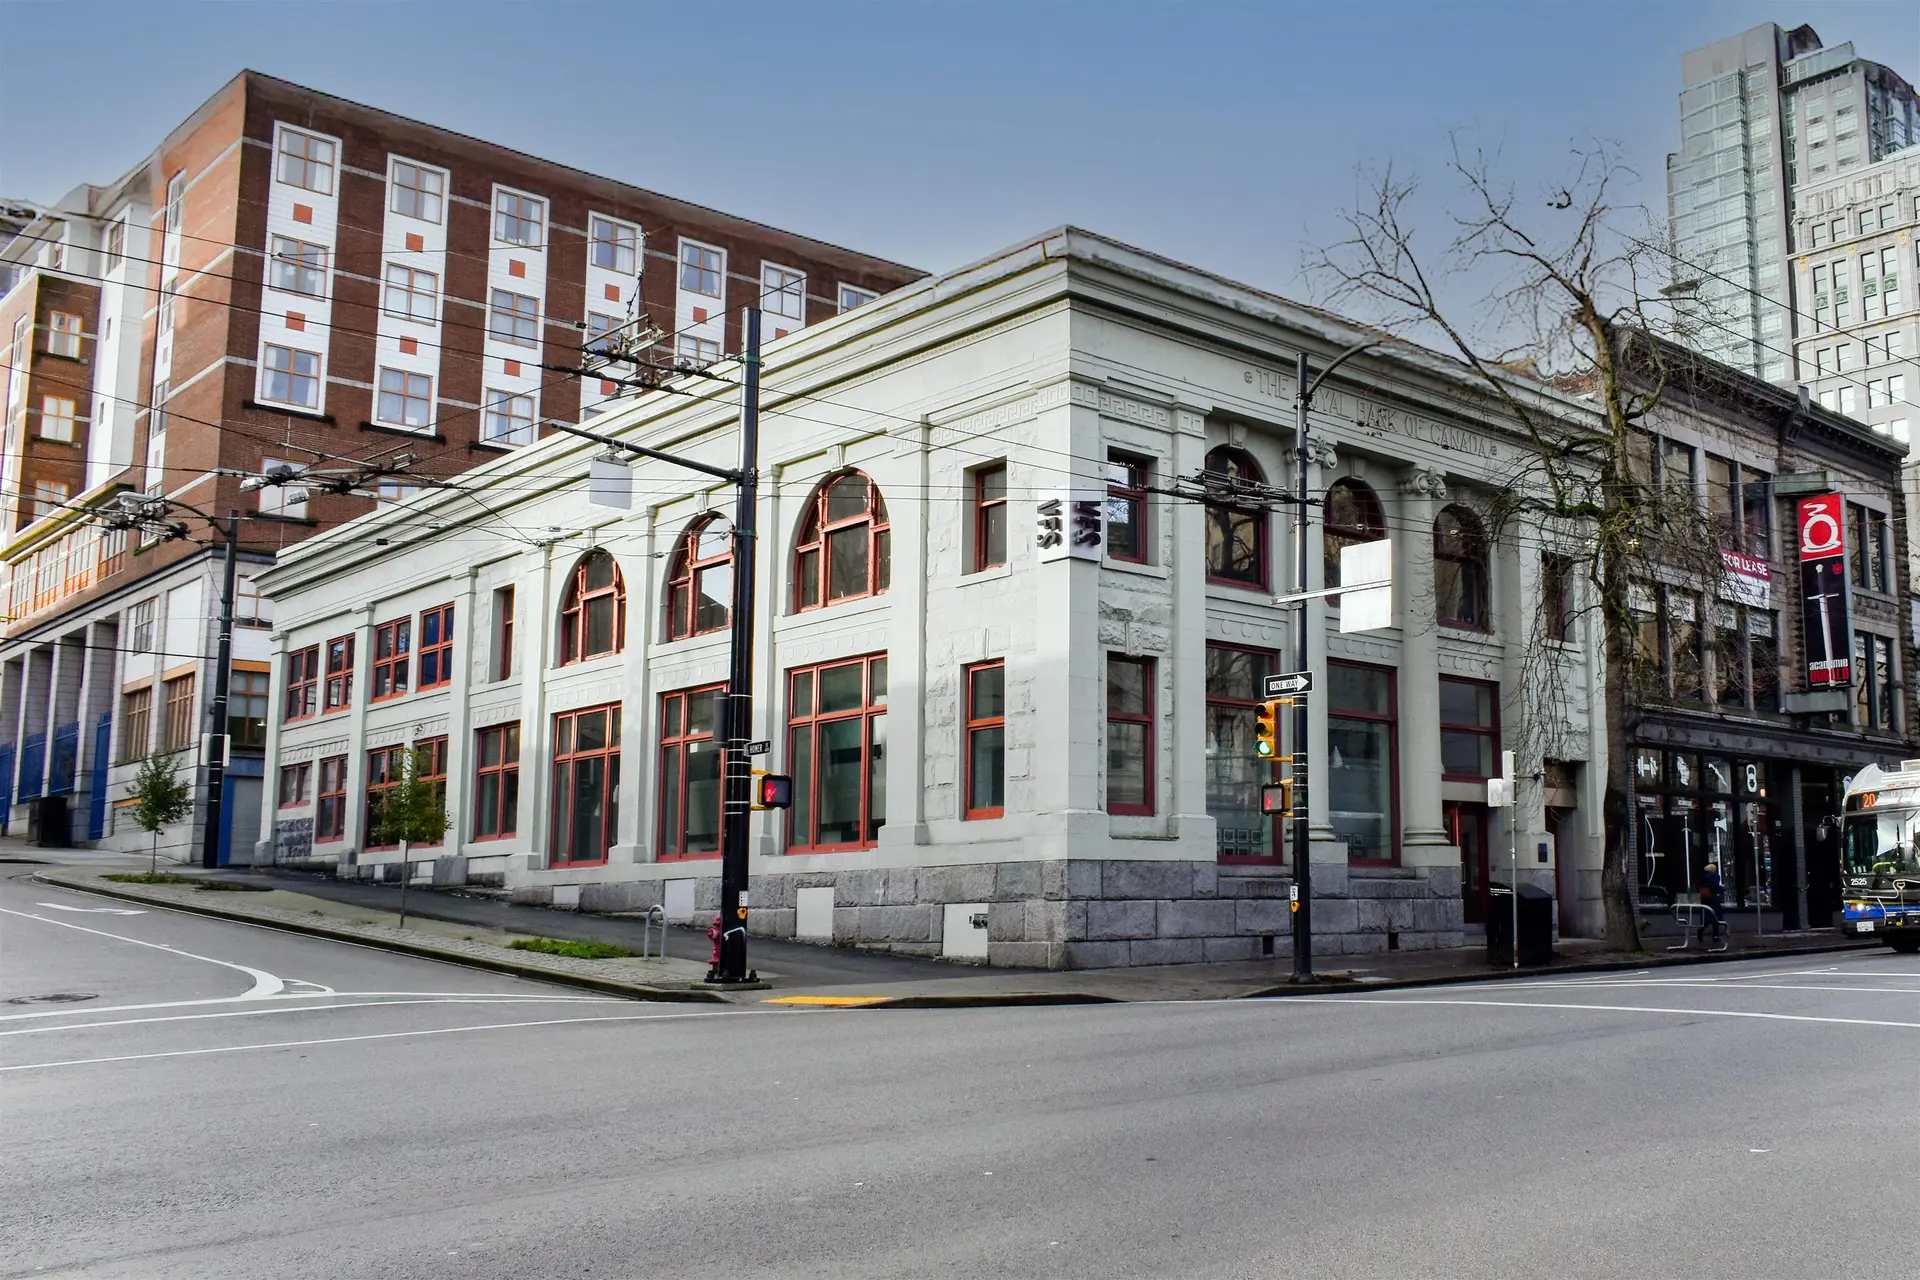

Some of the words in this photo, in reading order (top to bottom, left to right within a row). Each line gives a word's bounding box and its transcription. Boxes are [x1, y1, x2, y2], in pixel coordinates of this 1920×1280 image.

[1256, 368, 1289, 401] THE
[1304, 386, 1351, 418] OYAL
[1357, 400, 1398, 432] BANK
[1404, 415, 1425, 439] OF
[1431, 423, 1486, 458] CANADA
[1722, 553, 1740, 569] FOR
[1741, 558, 1768, 576] LEASE
[1271, 682, 1283, 690] ONE
[1285, 680, 1298, 688] WAY
[1862, 793, 1876, 808] 20
[1850, 878, 1868, 886] 2525
